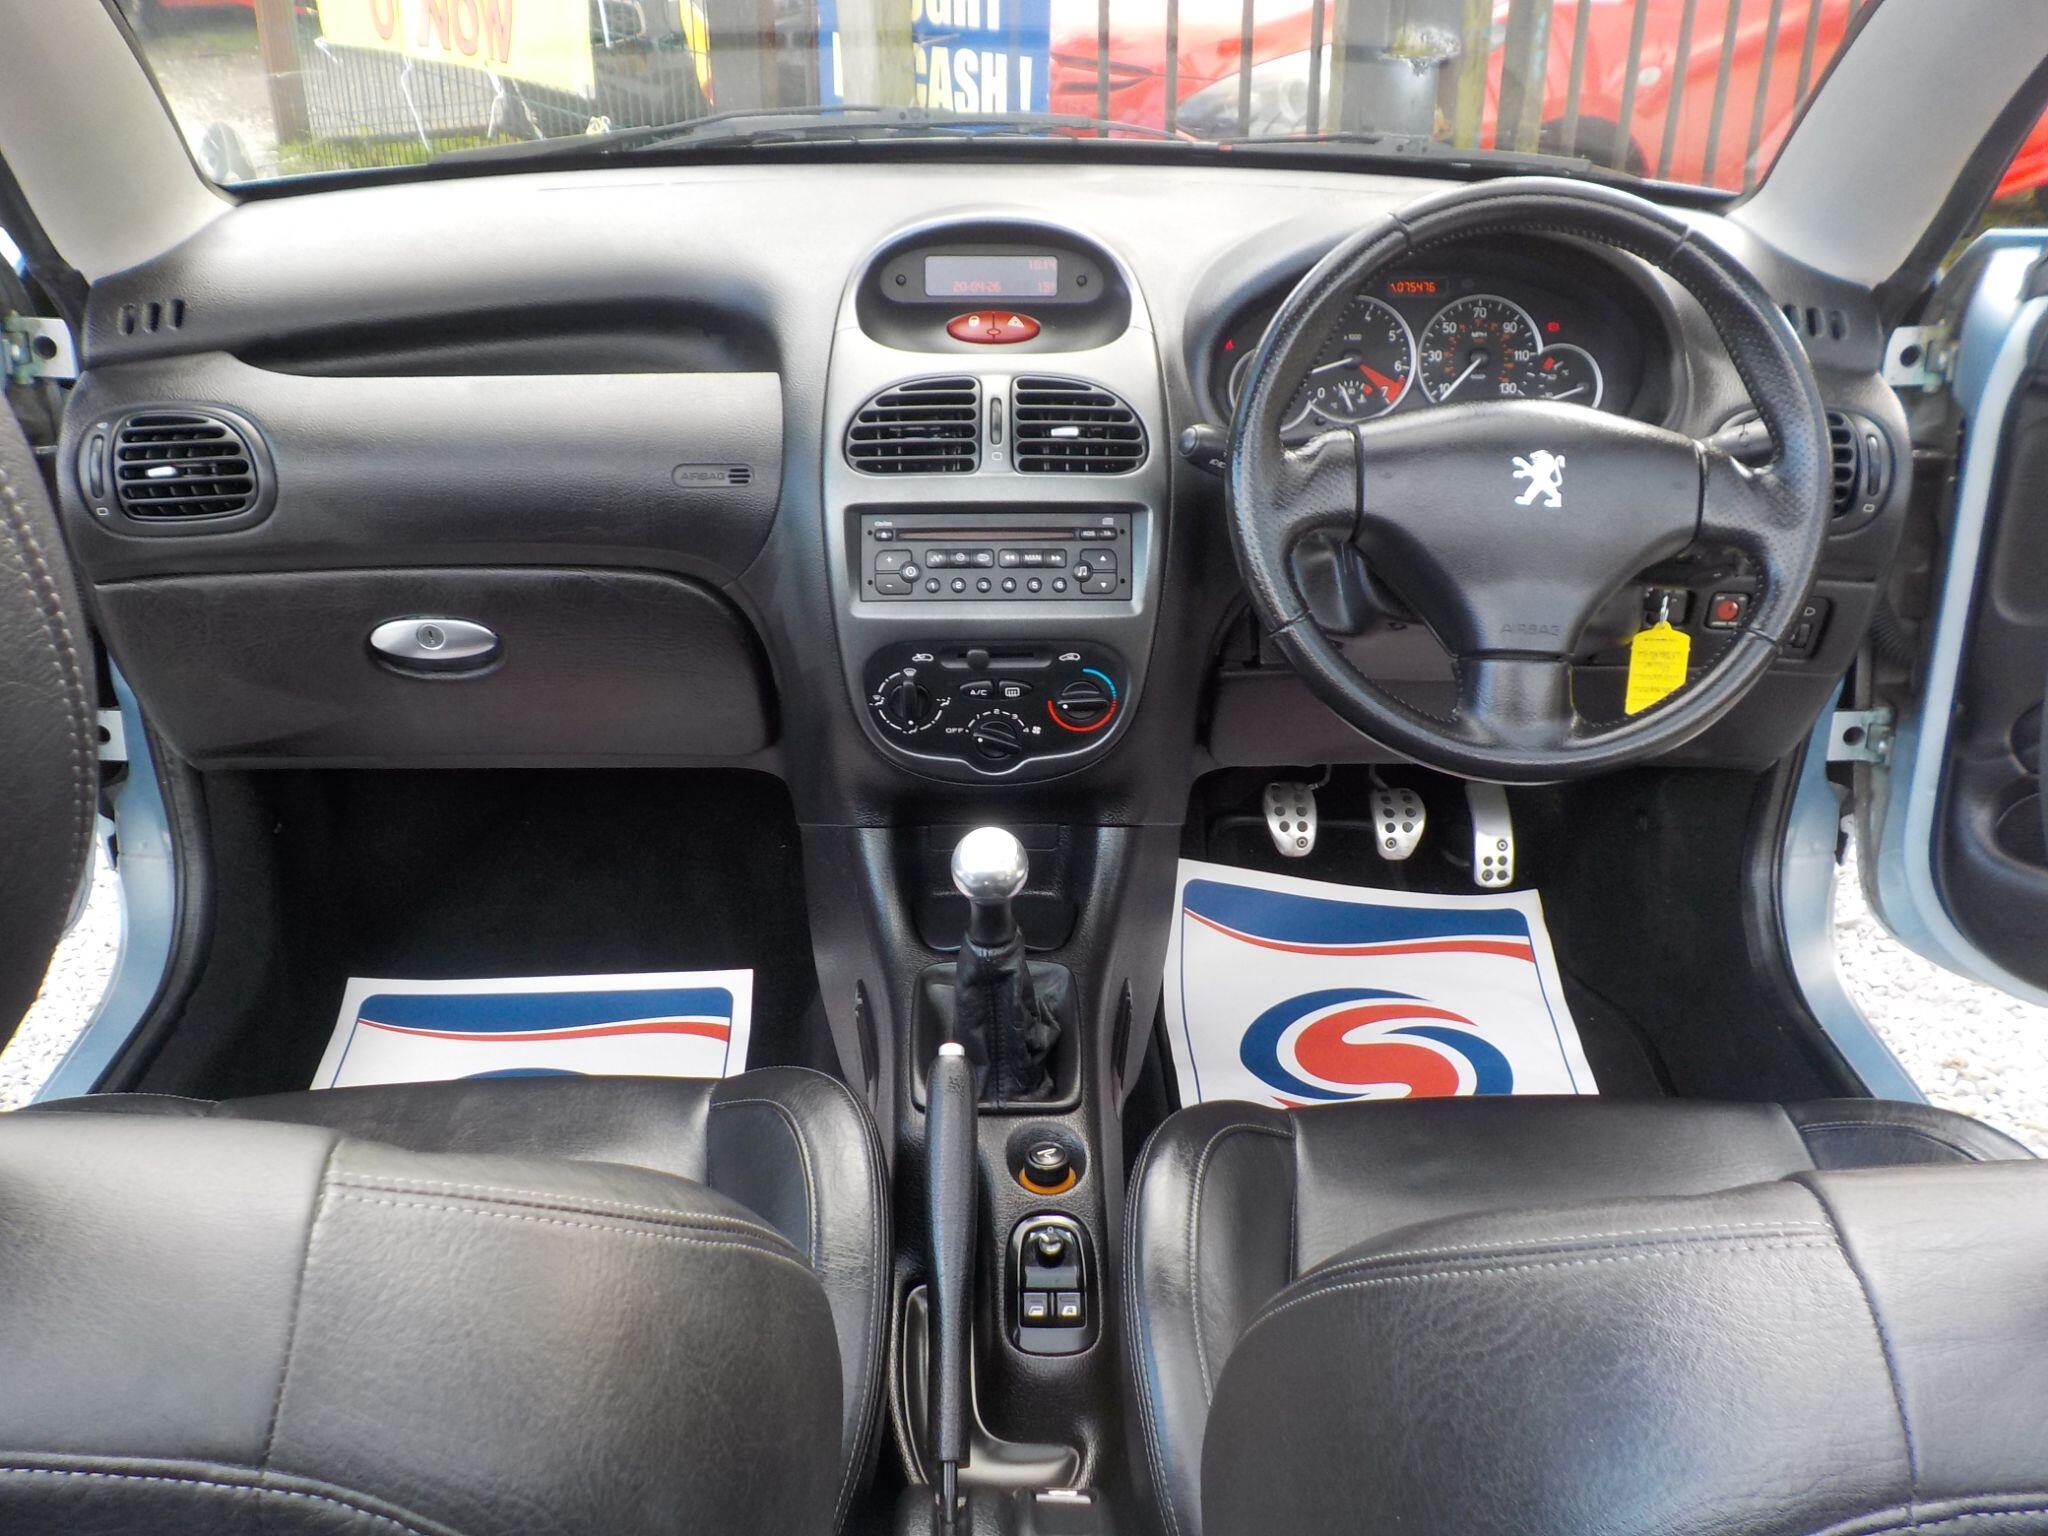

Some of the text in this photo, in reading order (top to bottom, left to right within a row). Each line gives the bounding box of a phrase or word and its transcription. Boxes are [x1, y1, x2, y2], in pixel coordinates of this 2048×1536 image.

[1473, 307, 1487, 318] 70
[1442, 322, 1457, 333] 50
[1503, 322, 1517, 333] 90
[1388, 330, 1396, 342] 5
[1428, 350, 1443, 361] 30
[1514, 350, 1529, 361] 110
[1394, 360, 1402, 371] 6
[1317, 387, 1325, 399] 0
[1381, 385, 1389, 397] 7
[1439, 382, 1451, 394] 10
[1499, 382, 1517, 394] 130
[681, 472, 725, 480] AIRBAG
[930, 582, 936, 590] 1
[955, 581, 962, 590] 2
[980, 581, 987, 589] 3
[1031, 582, 1038, 590] 5
[1057, 581, 1064, 589] 6
[1502, 623, 1560, 636] ARBAG
